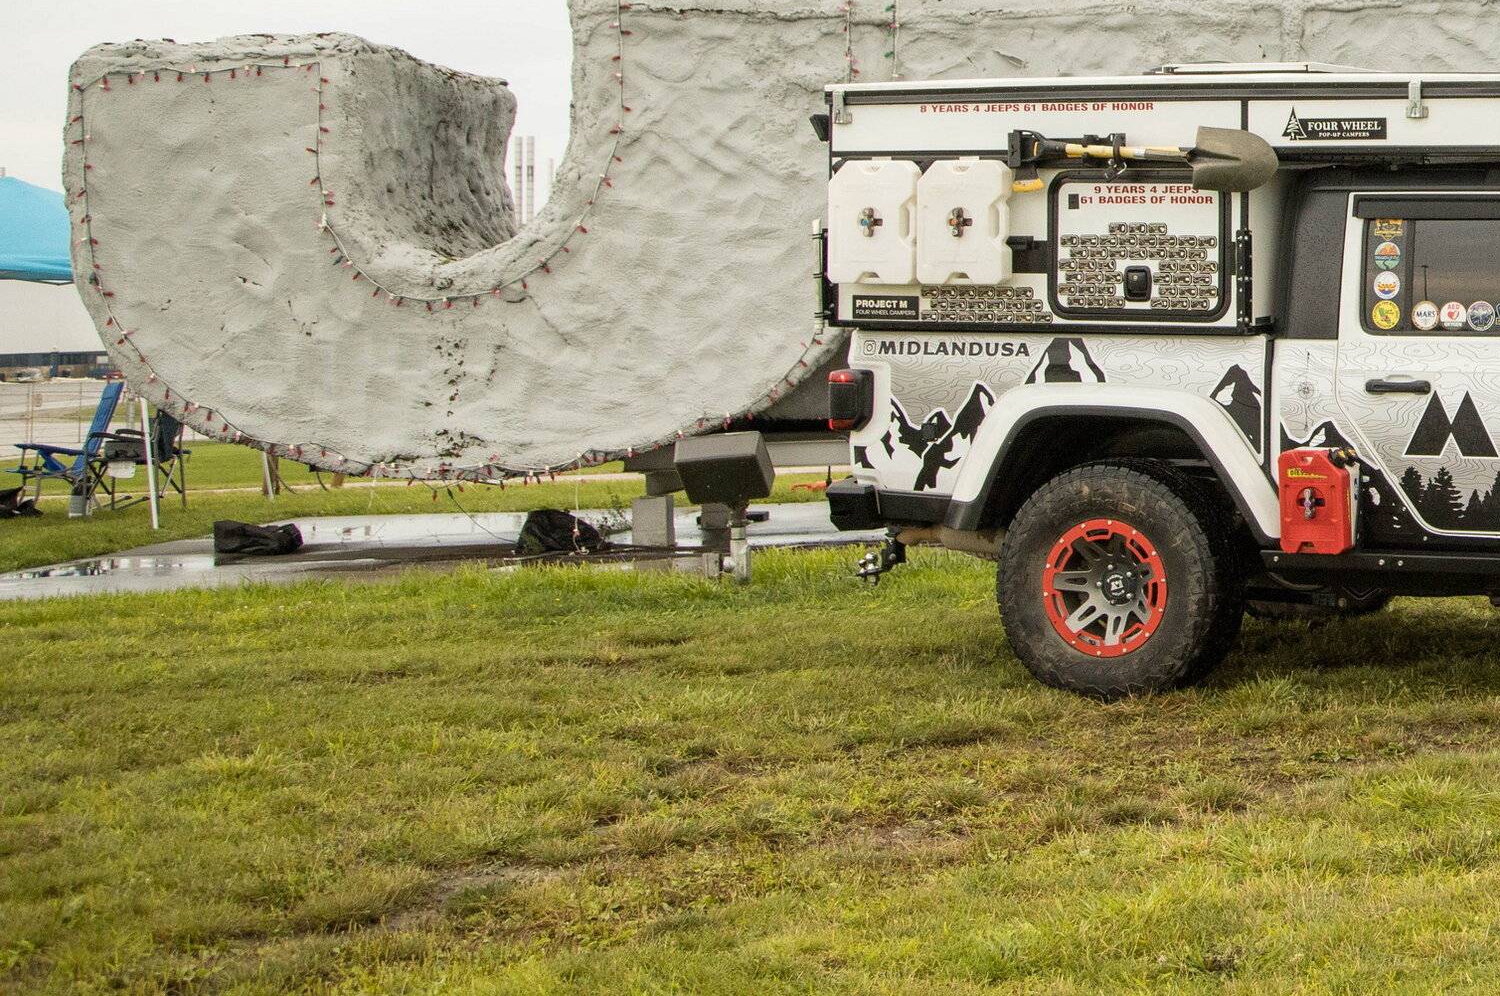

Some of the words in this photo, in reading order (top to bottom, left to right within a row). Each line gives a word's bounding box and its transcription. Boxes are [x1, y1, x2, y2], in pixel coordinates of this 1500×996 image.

[920, 105, 927, 113] 8
[932, 104, 969, 113] YEARS
[973, 104, 980, 113] 4
[984, 104, 1020, 113] JEEPS
[1023, 103, 1036, 112] 61
[1042, 103, 1088, 112] BADGES
[1092, 103, 1107, 112] OF
[1112, 102, 1154, 111] HONOR
[1307, 121, 1338, 131] FOUR
[1340, 121, 1381, 131] WHEEL
[1094, 185, 1101, 194] 9
[1105, 185, 1146, 194] YEARS
[1149, 185, 1157, 194] 4
[1162, 185, 1199, 194] JEEPS
[1080, 195, 1093, 204] 61
[1099, 195, 1146, 204] BADGES
[1150, 195, 1164, 204] OF
[1170, 195, 1213, 204] HONOR
[855, 299, 898, 308] PROJECT
[899, 300, 908, 309] M
[878, 340, 1030, 357] MIDLANDUSA
